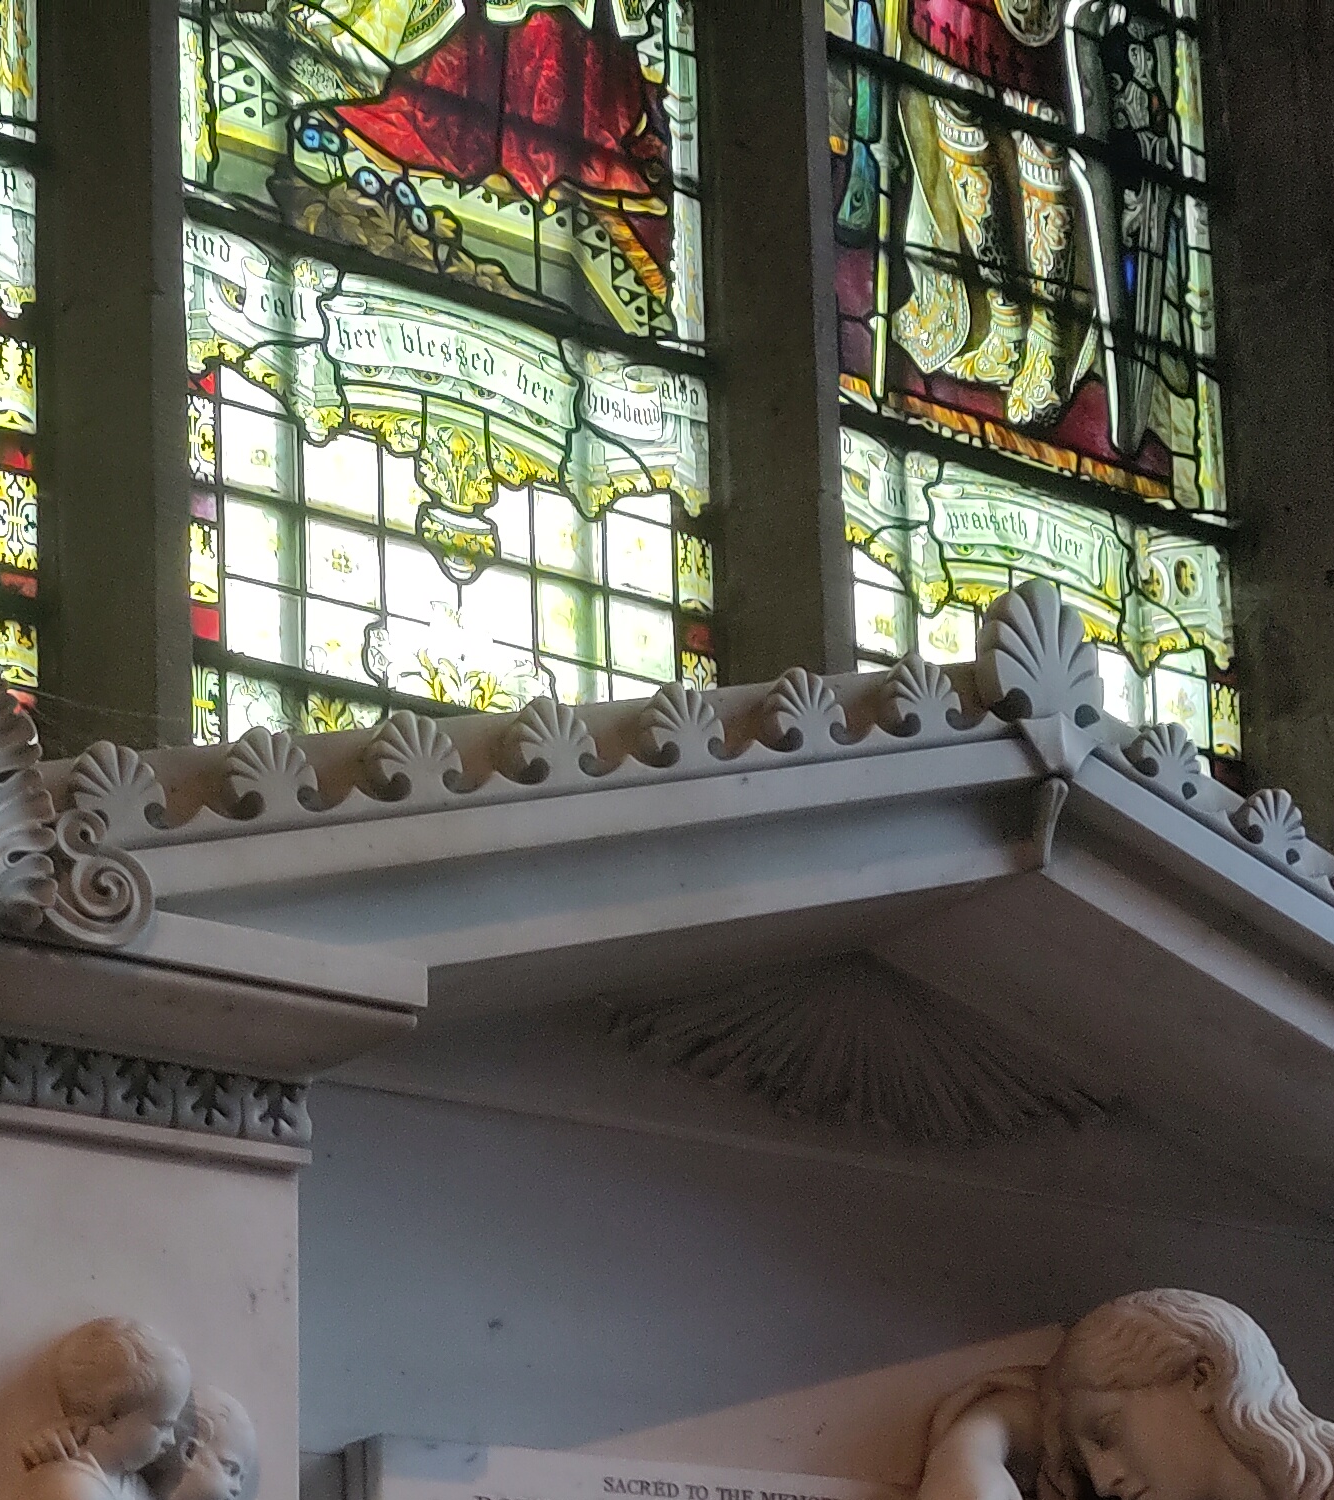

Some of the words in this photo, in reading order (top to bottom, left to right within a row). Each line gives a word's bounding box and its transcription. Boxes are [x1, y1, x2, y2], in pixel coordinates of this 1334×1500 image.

[183, 227, 233, 263] and
[259, 287, 307, 325] call
[335, 316, 379, 352] her
[400, 323, 496, 377] blessed
[515, 362, 556, 406] her
[584, 379, 664, 427] husband
[658, 375, 701, 409] also
[946, 506, 1029, 540] praiseth
[1052, 523, 1083, 560] her
[602, 1475, 679, 1499] SACRED
[685, 1484, 709, 1500] TO
